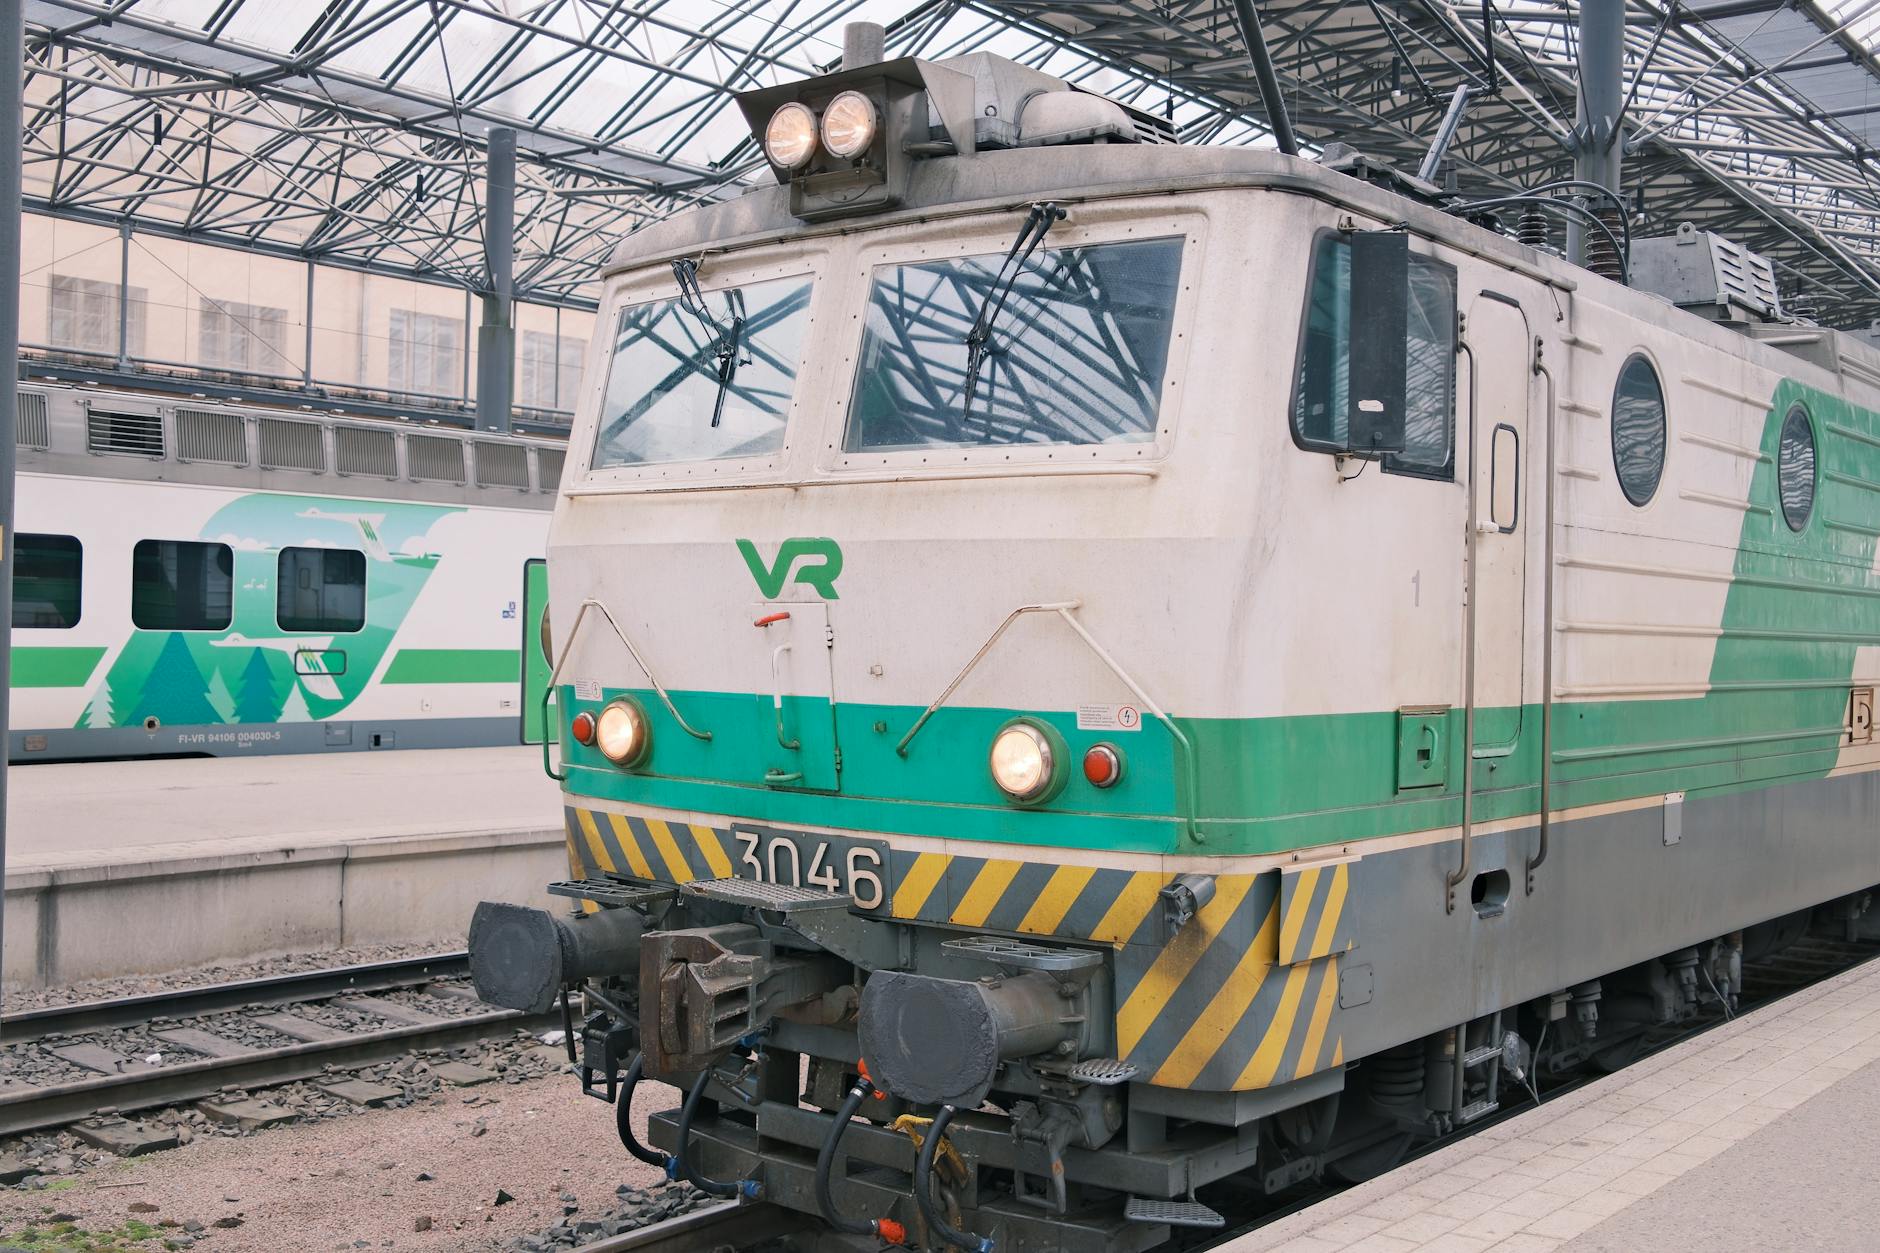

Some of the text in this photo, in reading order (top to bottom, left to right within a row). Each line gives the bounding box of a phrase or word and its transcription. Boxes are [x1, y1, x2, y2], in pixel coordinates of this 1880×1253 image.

[735, 537, 843, 600] VR
[1412, 569, 1420, 608] 1
[178, 731, 281, 744] FI-VR 94106 004030-5
[735, 831, 883, 910] 3046
